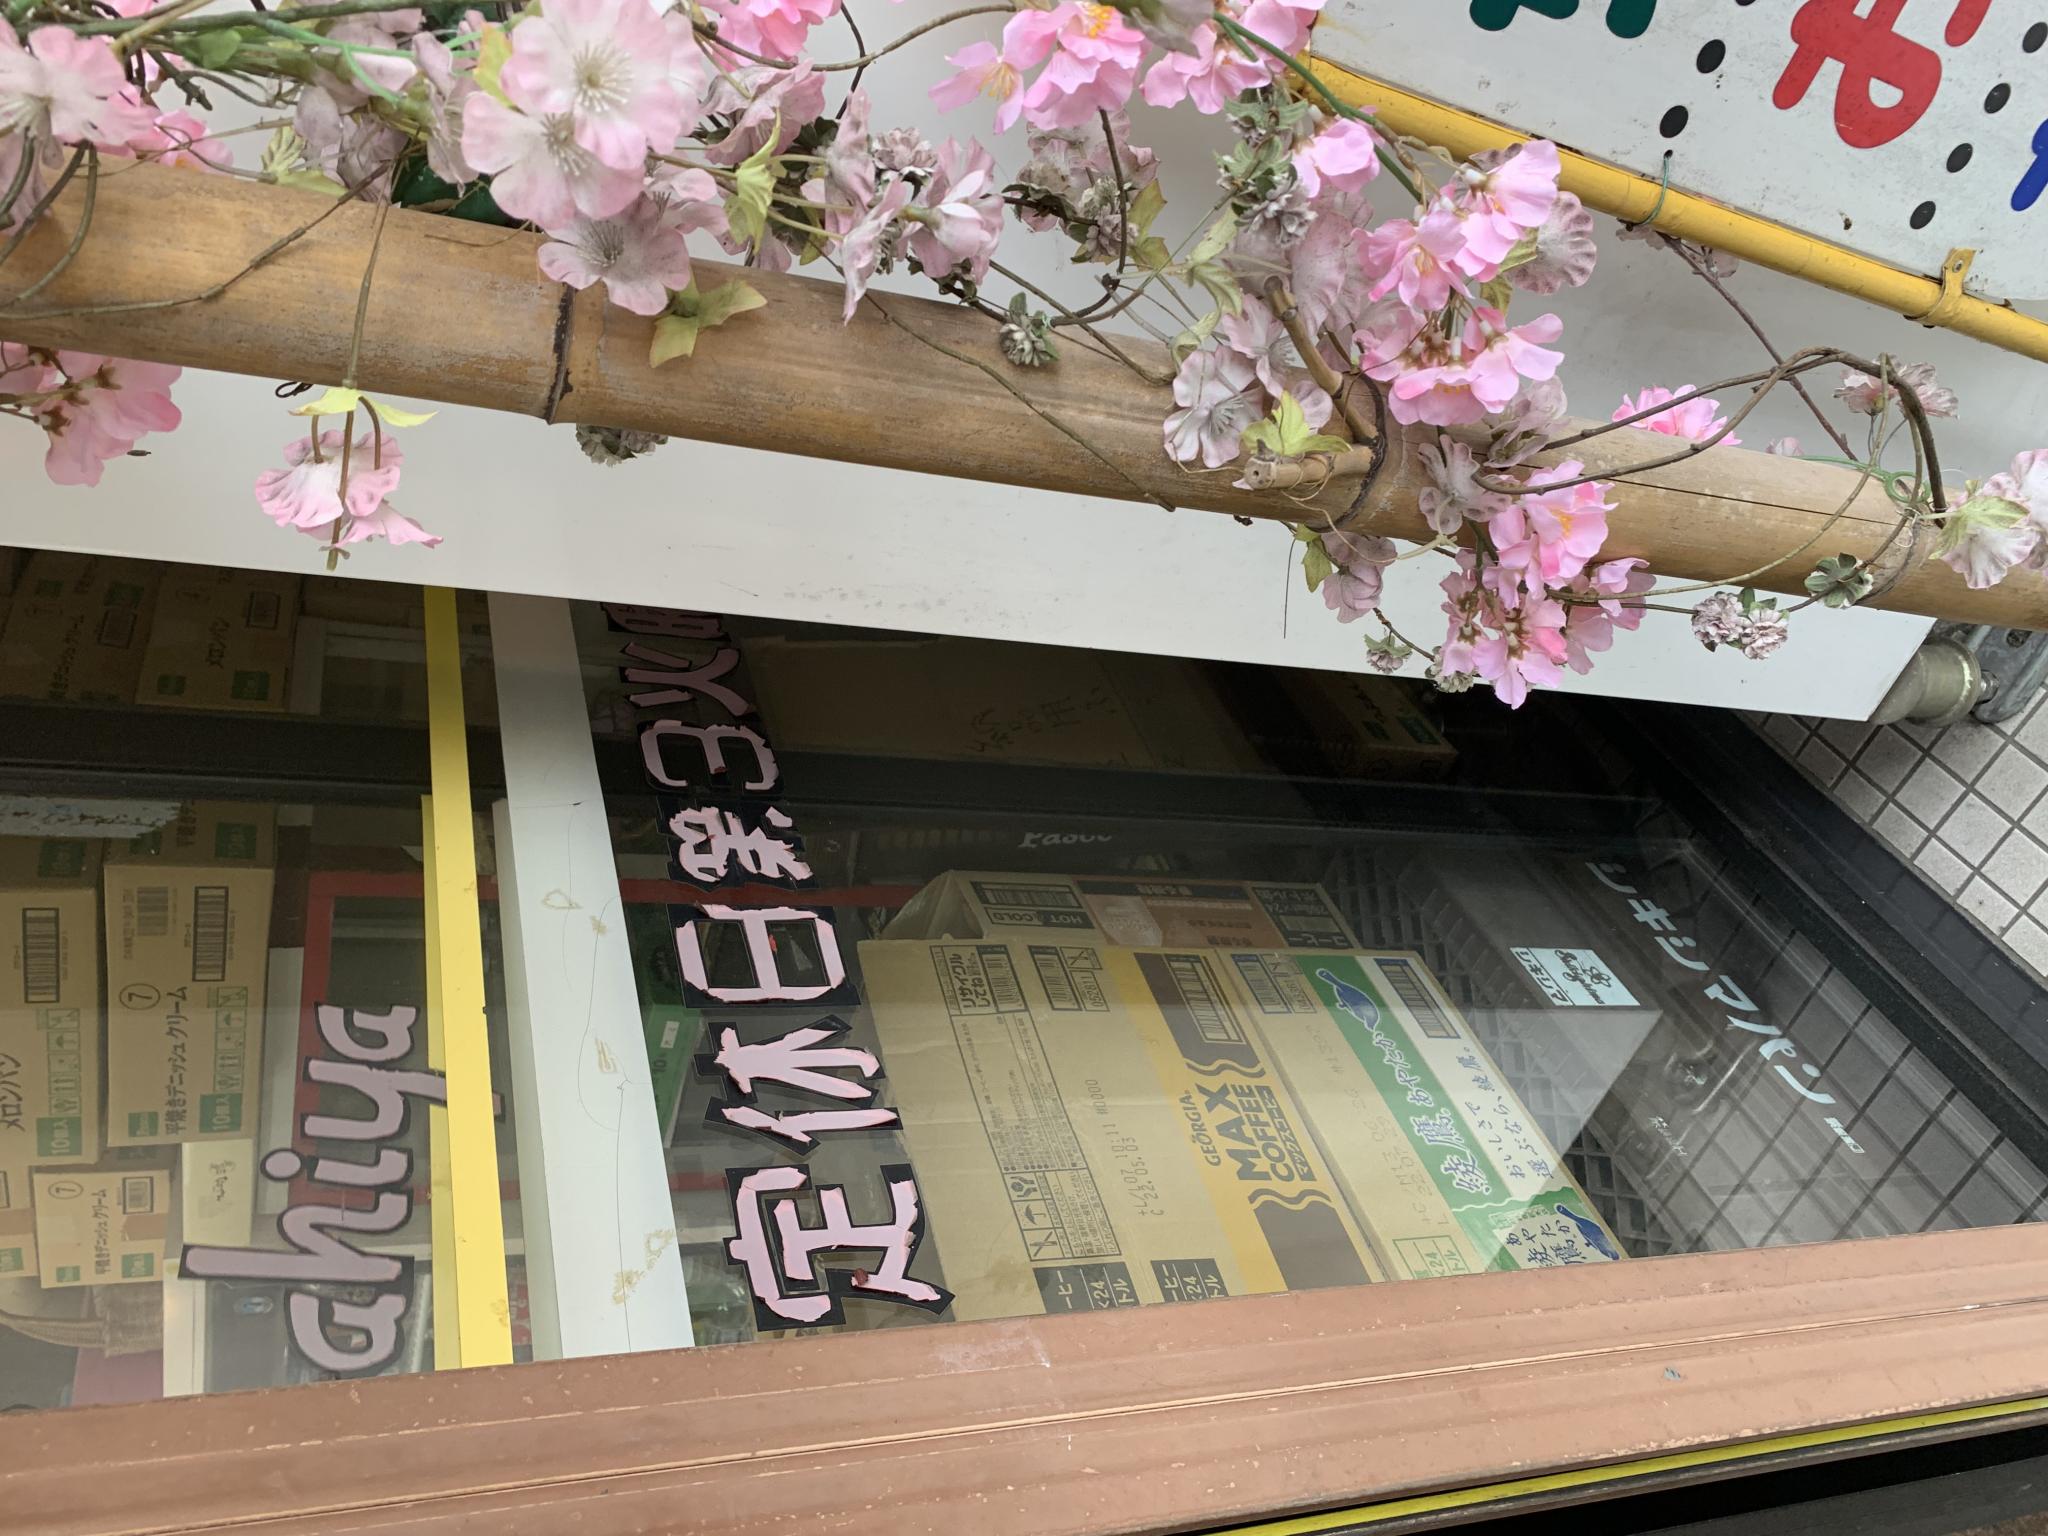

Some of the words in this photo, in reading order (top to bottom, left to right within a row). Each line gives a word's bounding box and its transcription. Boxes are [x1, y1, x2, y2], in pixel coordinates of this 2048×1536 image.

[165, 986, 188, 1038] クリーム
[950, 953, 976, 1008] リサイクル
[971, 977, 991, 1008] してね
[1515, 950, 1570, 1003] シキシマ
[1584, 861, 1837, 1106] シキシマパン
[166, 1043, 187, 1135] 平焼きデニッシュ
[1372, 1031, 1434, 1107] あやたか
[1454, 1045, 1554, 1179] 選ぶなら、綾鷹。
[1194, 1082, 1273, 1182] MAX
[1230, 1084, 1296, 1183] COFFEE
[1261, 1089, 1311, 1177] マックスコーヒー
[1410, 1106, 1492, 1196] 綾鷹
[1464, 1100, 1526, 1179] おいしさで
[178, 1002, 450, 1371] ahiya
[1505, 1219, 1571, 1247] あやたか
